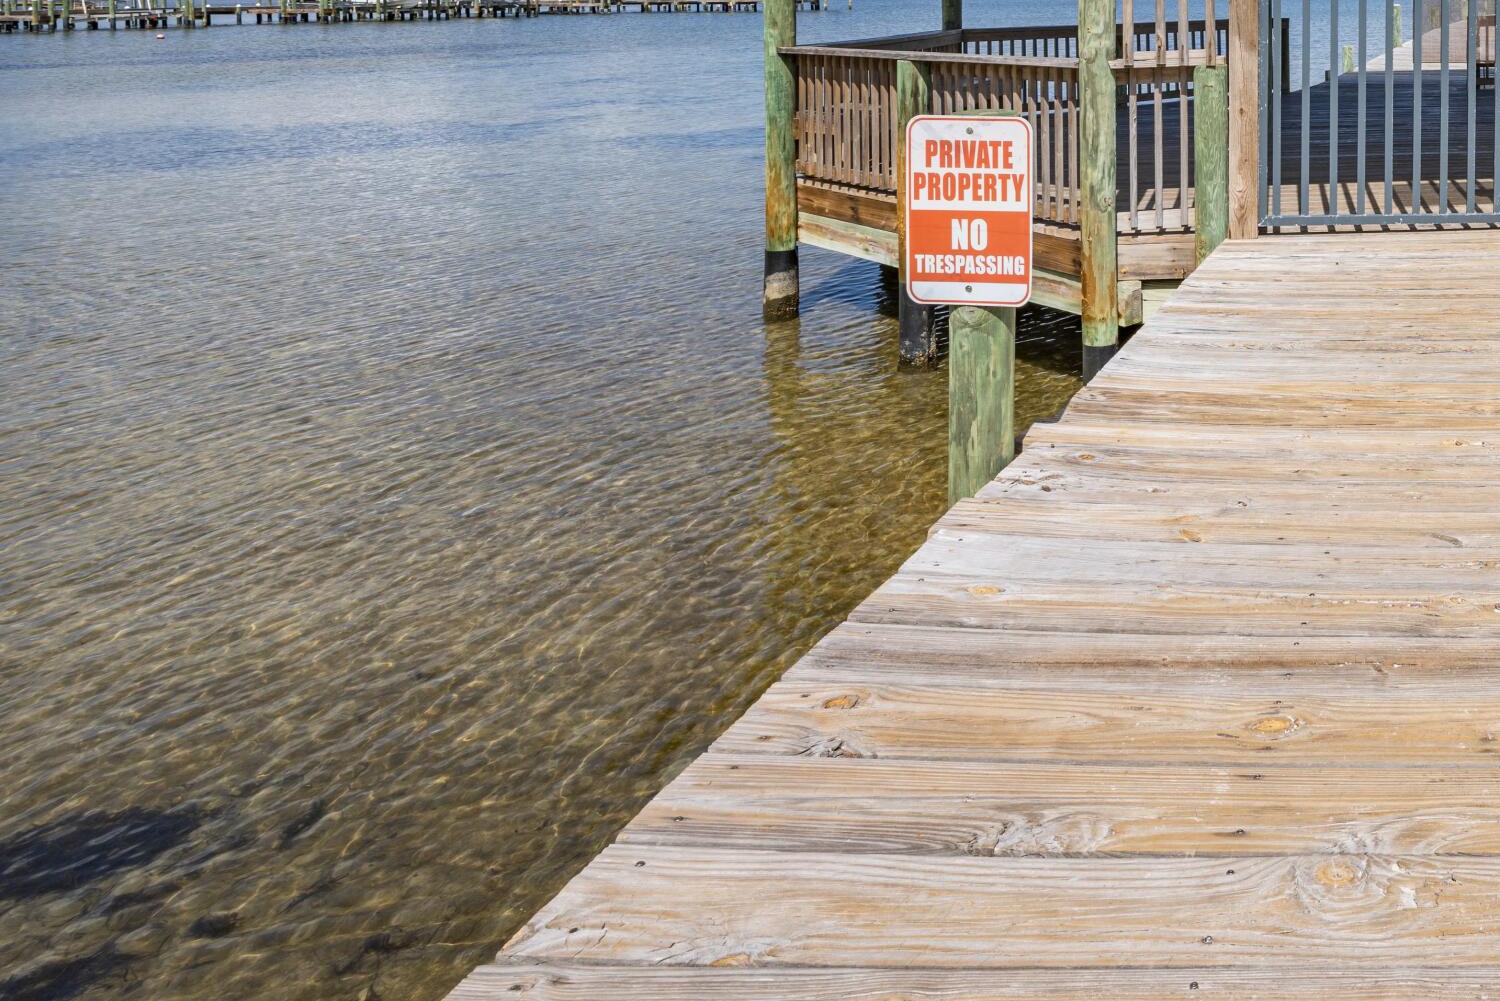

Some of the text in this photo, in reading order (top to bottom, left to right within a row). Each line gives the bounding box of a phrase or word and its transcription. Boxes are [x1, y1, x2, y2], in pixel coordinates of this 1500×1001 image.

[925, 140, 1013, 169] PRIVATE
[913, 172, 1025, 202] PROPERTY
[951, 218, 988, 251] NO
[914, 254, 1025, 276] TRESPASSING
